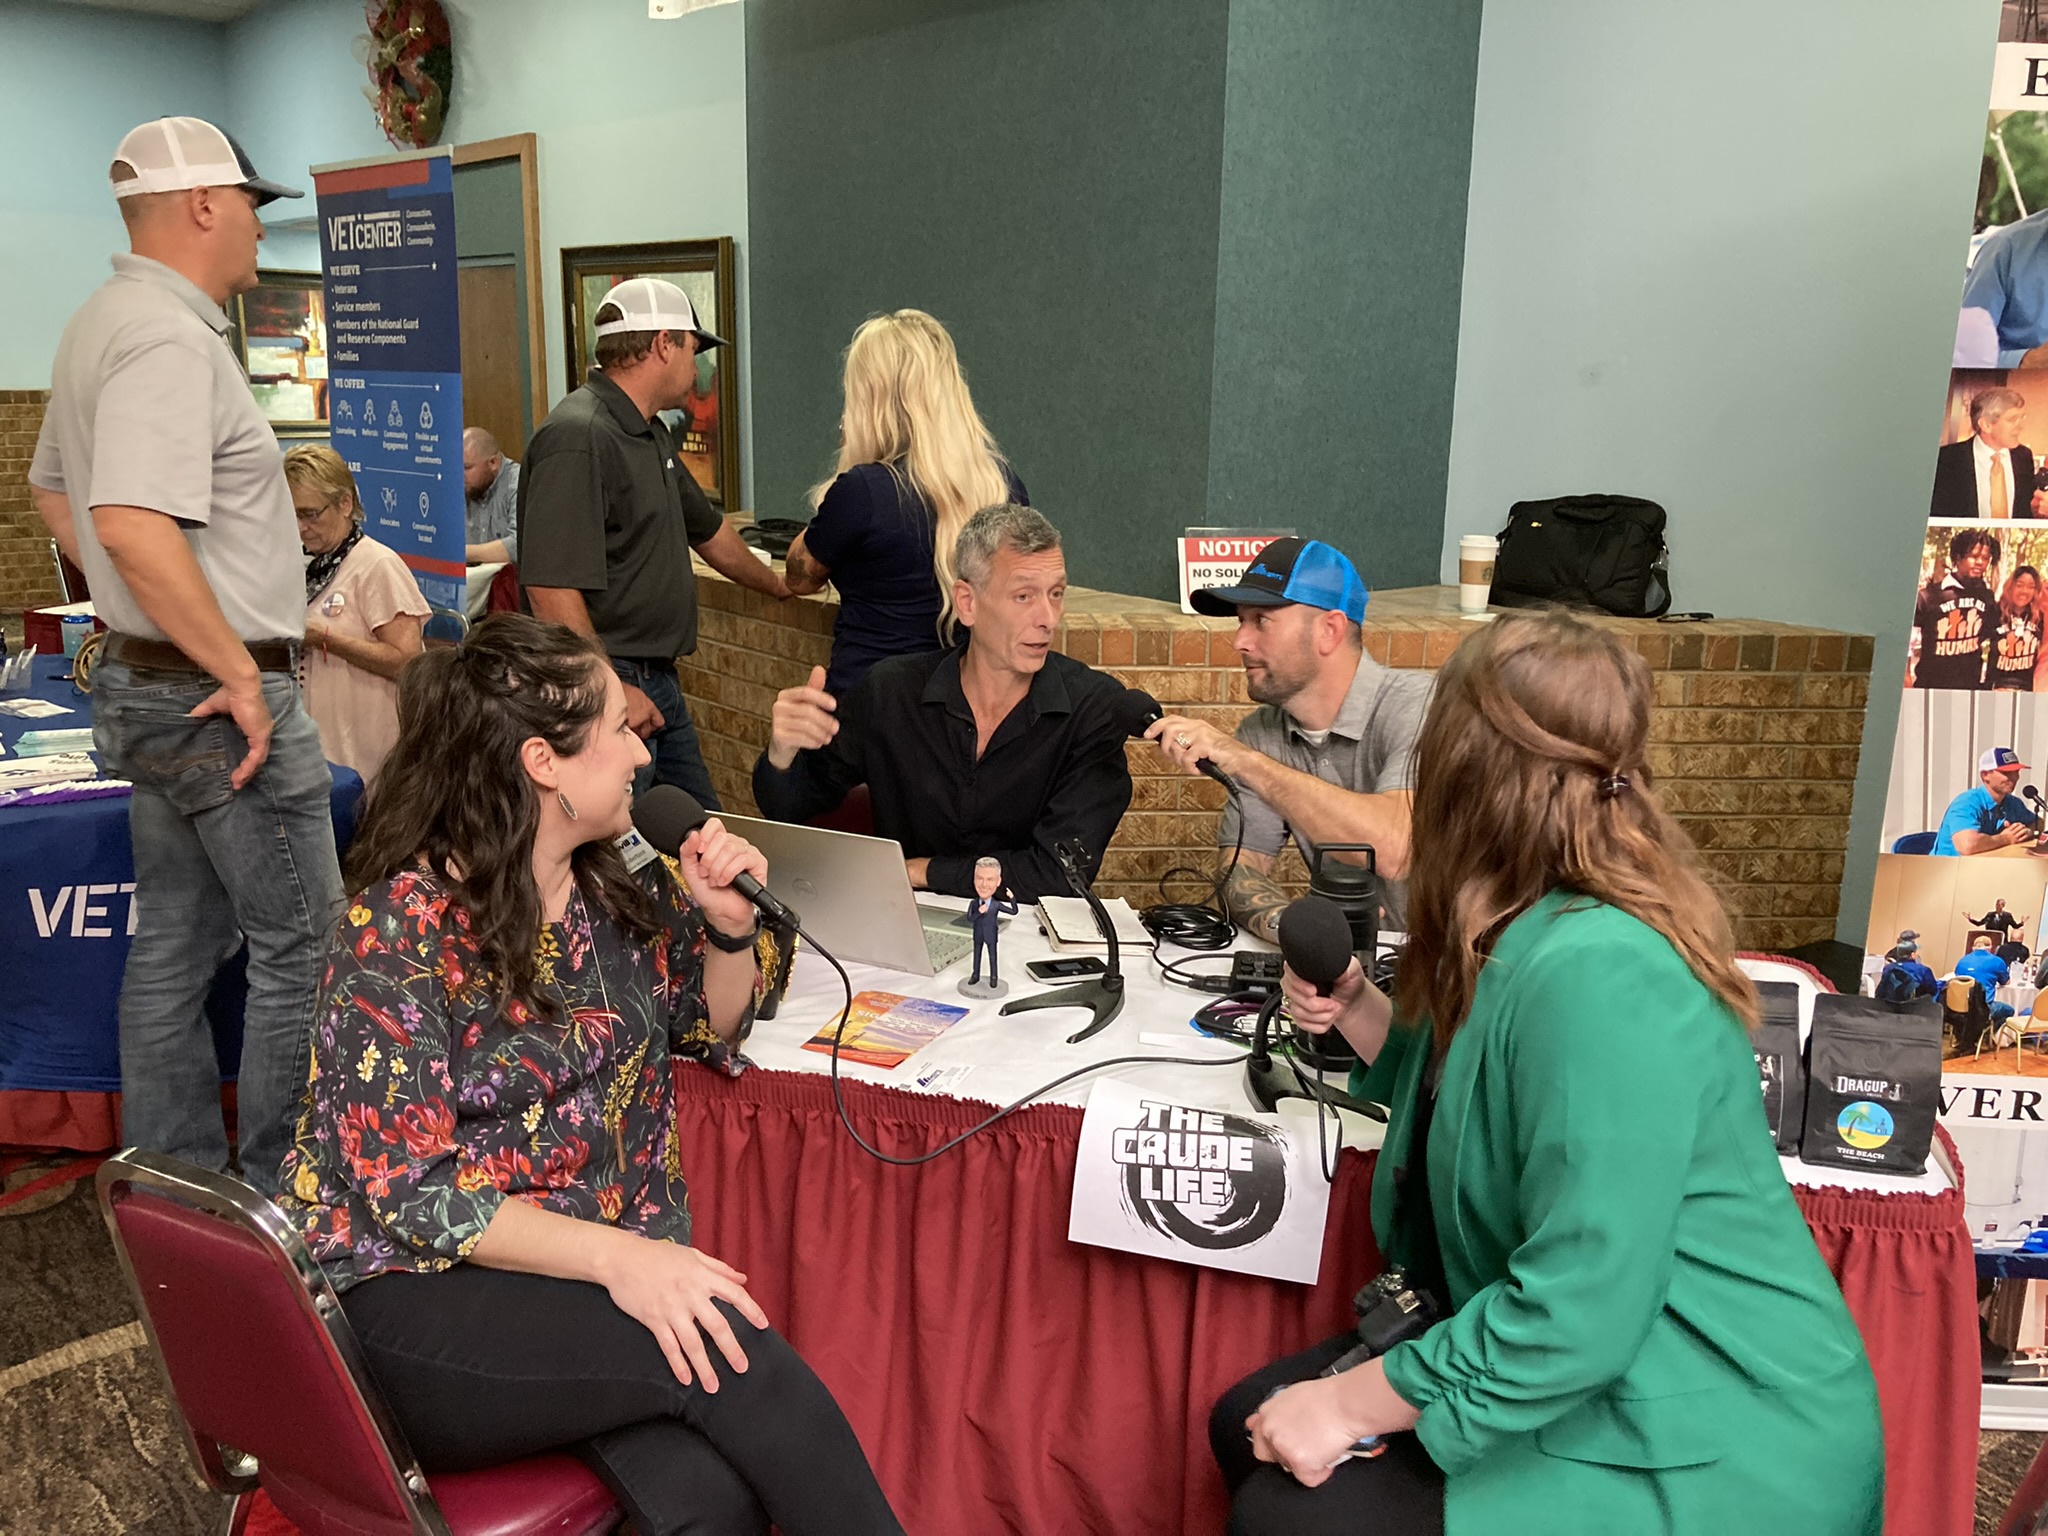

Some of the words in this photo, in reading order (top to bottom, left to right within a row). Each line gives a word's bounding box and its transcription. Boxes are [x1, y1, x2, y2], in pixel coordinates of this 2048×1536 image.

[355, 220, 402, 250] CENTER
[335, 302, 354, 312] Service
[355, 301, 381, 312] members
[335, 319, 360, 330] Members
[361, 318, 368, 330] of
[377, 318, 402, 330] National
[403, 317, 419, 330] Guard
[337, 333, 347, 344] and
[347, 333, 371, 344] Reserve
[371, 333, 407, 346] Components
[334, 378, 344, 389] WE
[344, 378, 366, 389] OFFER
[1192, 568, 1212, 578] NO
[1836, 1075, 1888, 1094] DRAGUP
[1140, 1099, 1225, 1134] THE
[1112, 1127, 1255, 1173] CRUDE
[1836, 1146, 1856, 1156] THE
[1856, 1149, 1885, 1160] BEACH
[1140, 1166, 1228, 1206] LIFE
